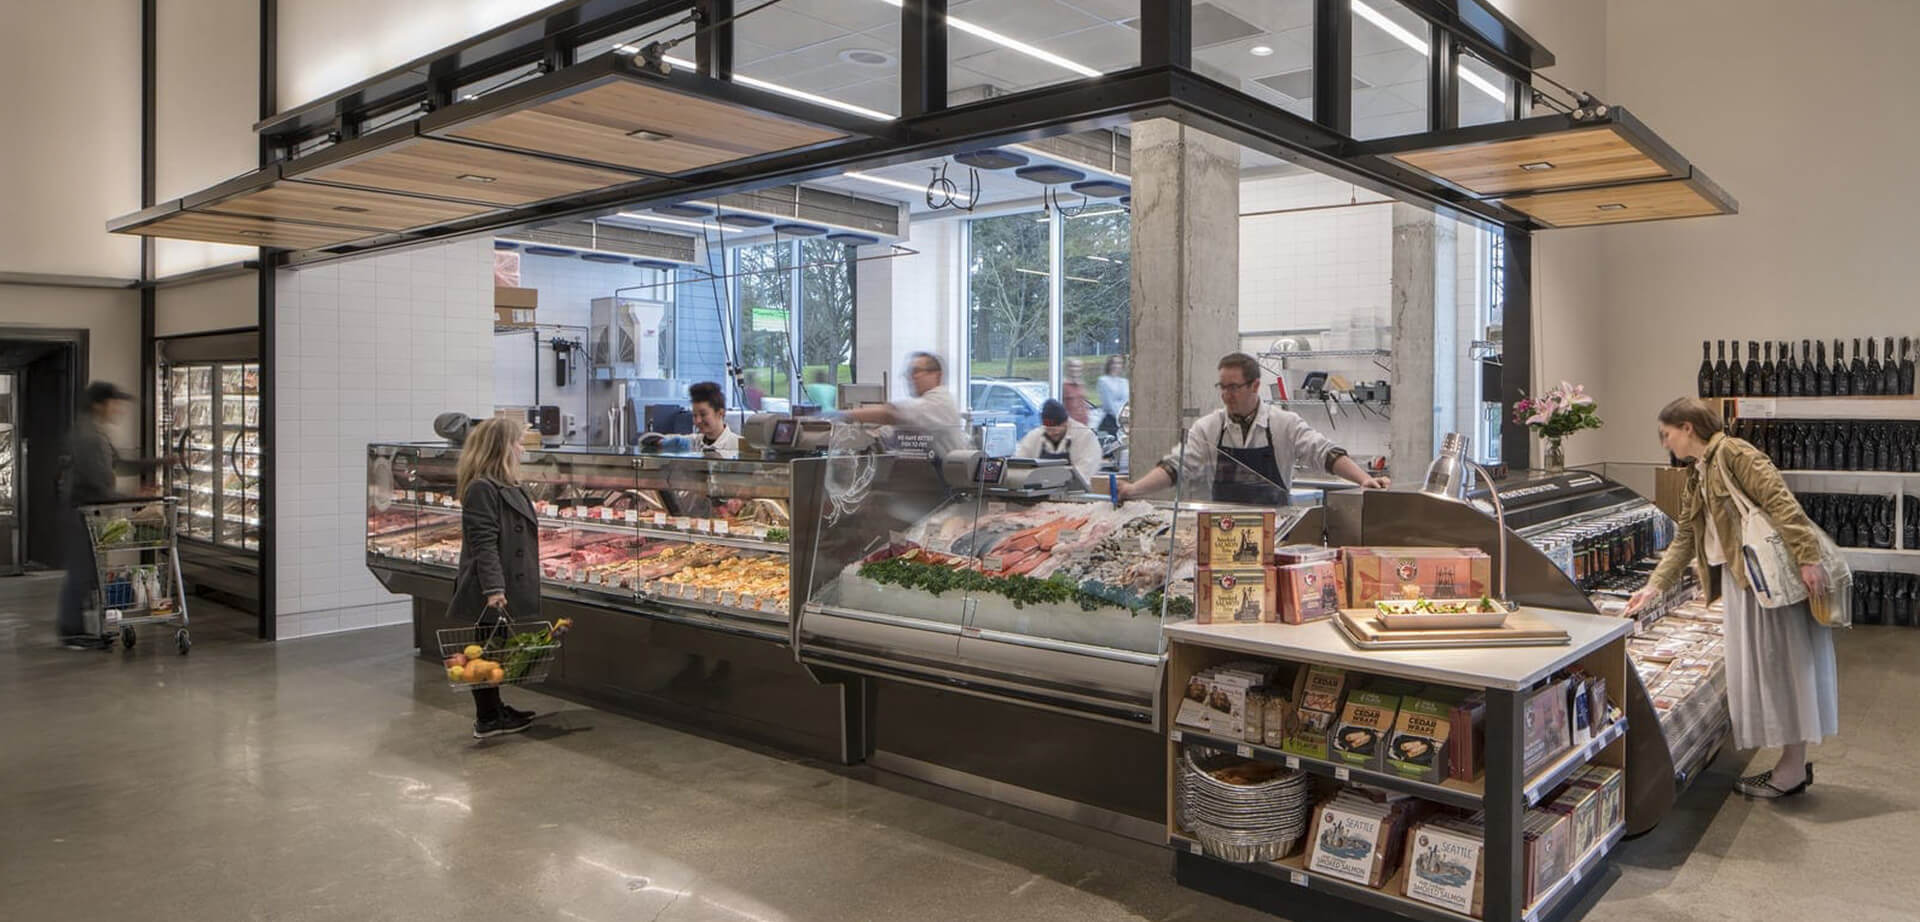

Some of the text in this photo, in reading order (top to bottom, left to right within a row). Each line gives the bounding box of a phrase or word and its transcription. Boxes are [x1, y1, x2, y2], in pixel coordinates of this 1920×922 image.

[1353, 708, 1381, 720] CEDAR
[1352, 715, 1379, 726] WRAPS
[1408, 717, 1437, 728] CEDAR
[1407, 724, 1435, 735] WRAPS
[1345, 816, 1375, 833] SEATTLE
[1440, 841, 1473, 858] SEATTLE
[1341, 862, 1366, 875] SALMON
[1440, 889, 1467, 904] SALMON
